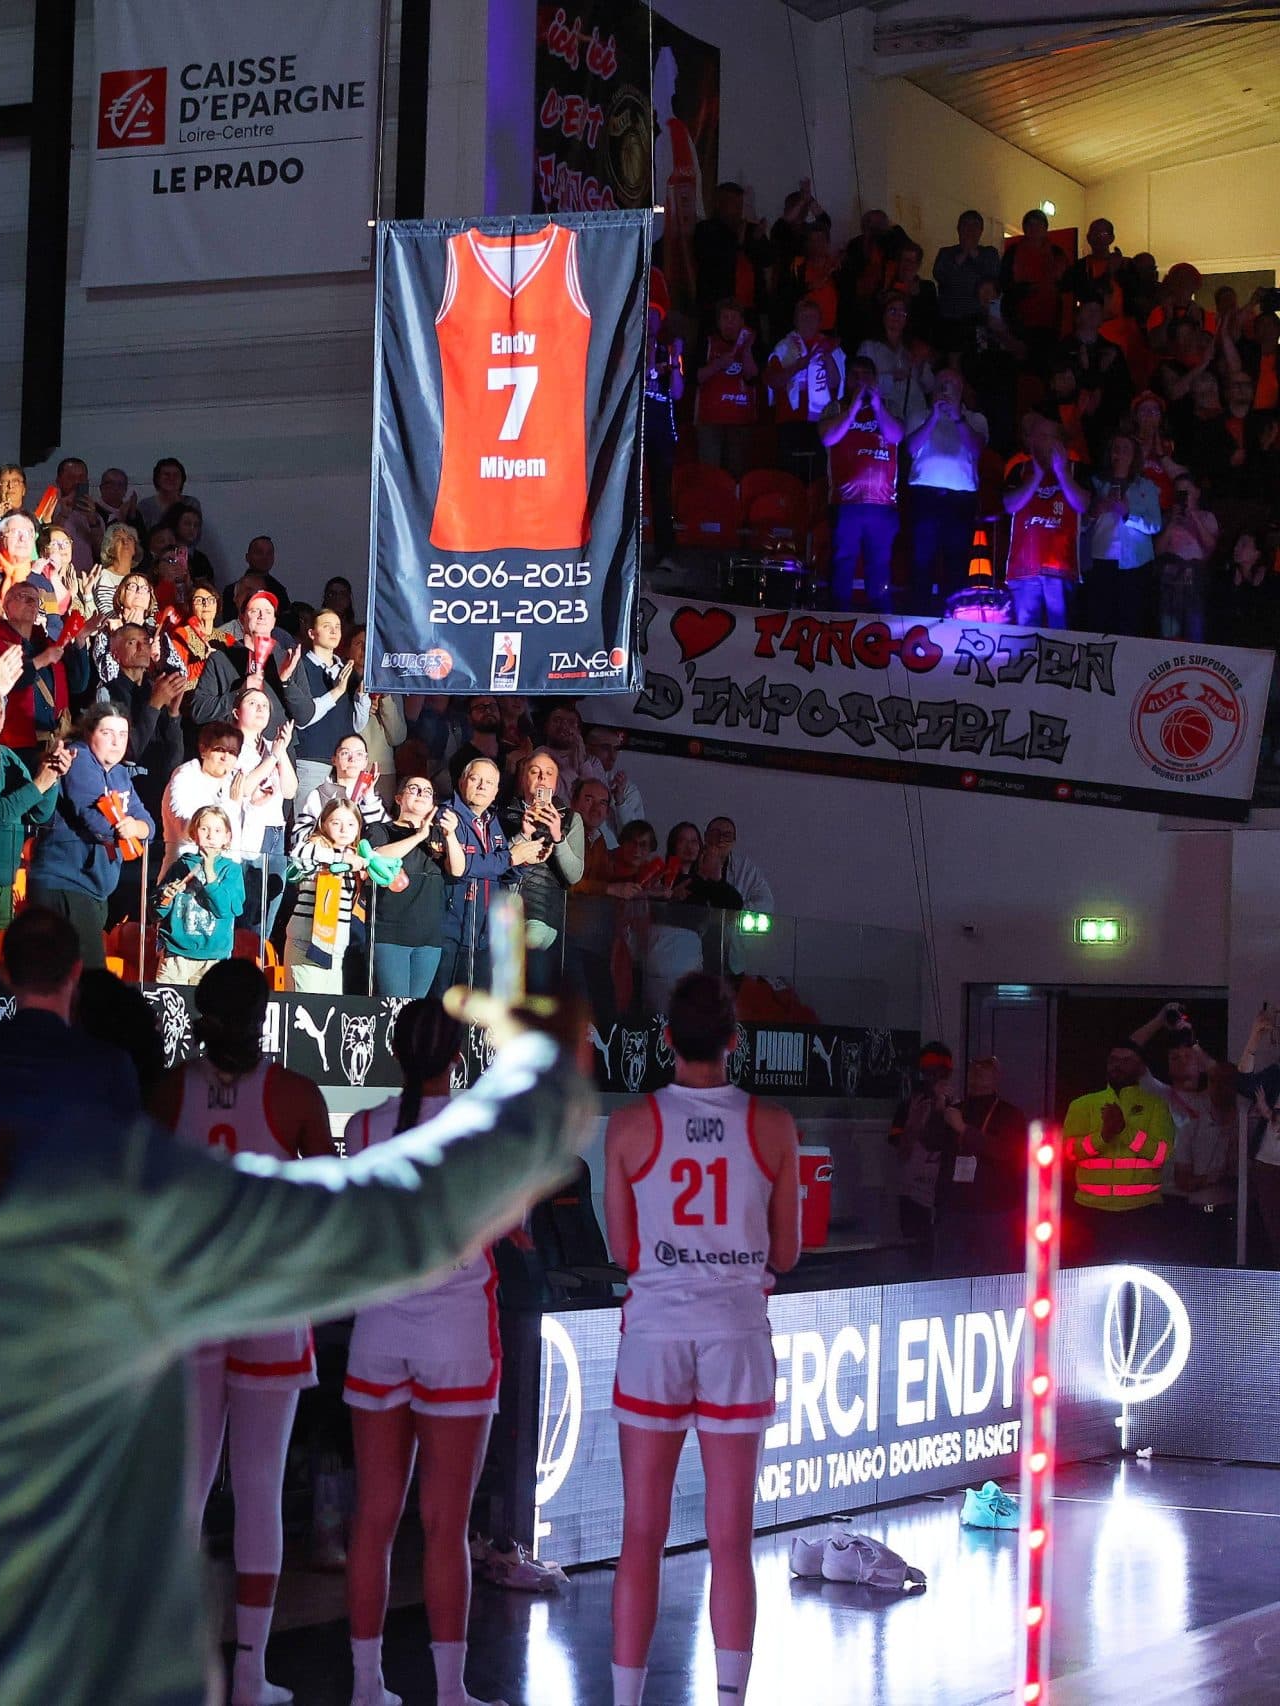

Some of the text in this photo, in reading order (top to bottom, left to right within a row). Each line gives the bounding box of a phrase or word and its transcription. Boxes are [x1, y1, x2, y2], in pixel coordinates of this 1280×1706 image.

[180, 55, 296, 90] CAISSE
[179, 81, 365, 124] D'EPARGNE
[179, 123, 274, 143] Loire-Centre
[153, 157, 304, 194] LE PRADO
[491, 331, 537, 355] Endy
[487, 366, 538, 441] 7
[480, 456, 546, 480] Miyem
[426, 561, 592, 589] 2006-2015
[429, 599, 589, 626] 2021-2023
[549, 647, 626, 673] TANGO
[754, 611, 1117, 696] TANGO RIEN
[1148, 660, 1171, 681] CLUB
[1173, 655, 1186, 667] DE
[755, 1030, 805, 1072] PUMA
[754, 1072, 803, 1086] BASKETBALL
[685, 1117, 724, 1143] GUAPO
[670, 1157, 728, 1226] 21
[765, 1307, 1026, 1449] ERCI ENDY
[796, 1456, 822, 1496] DU
[826, 1445, 886, 1489] TANGO
[889, 1431, 961, 1478] BOURGES
[965, 1420, 1021, 1461] BASKET
